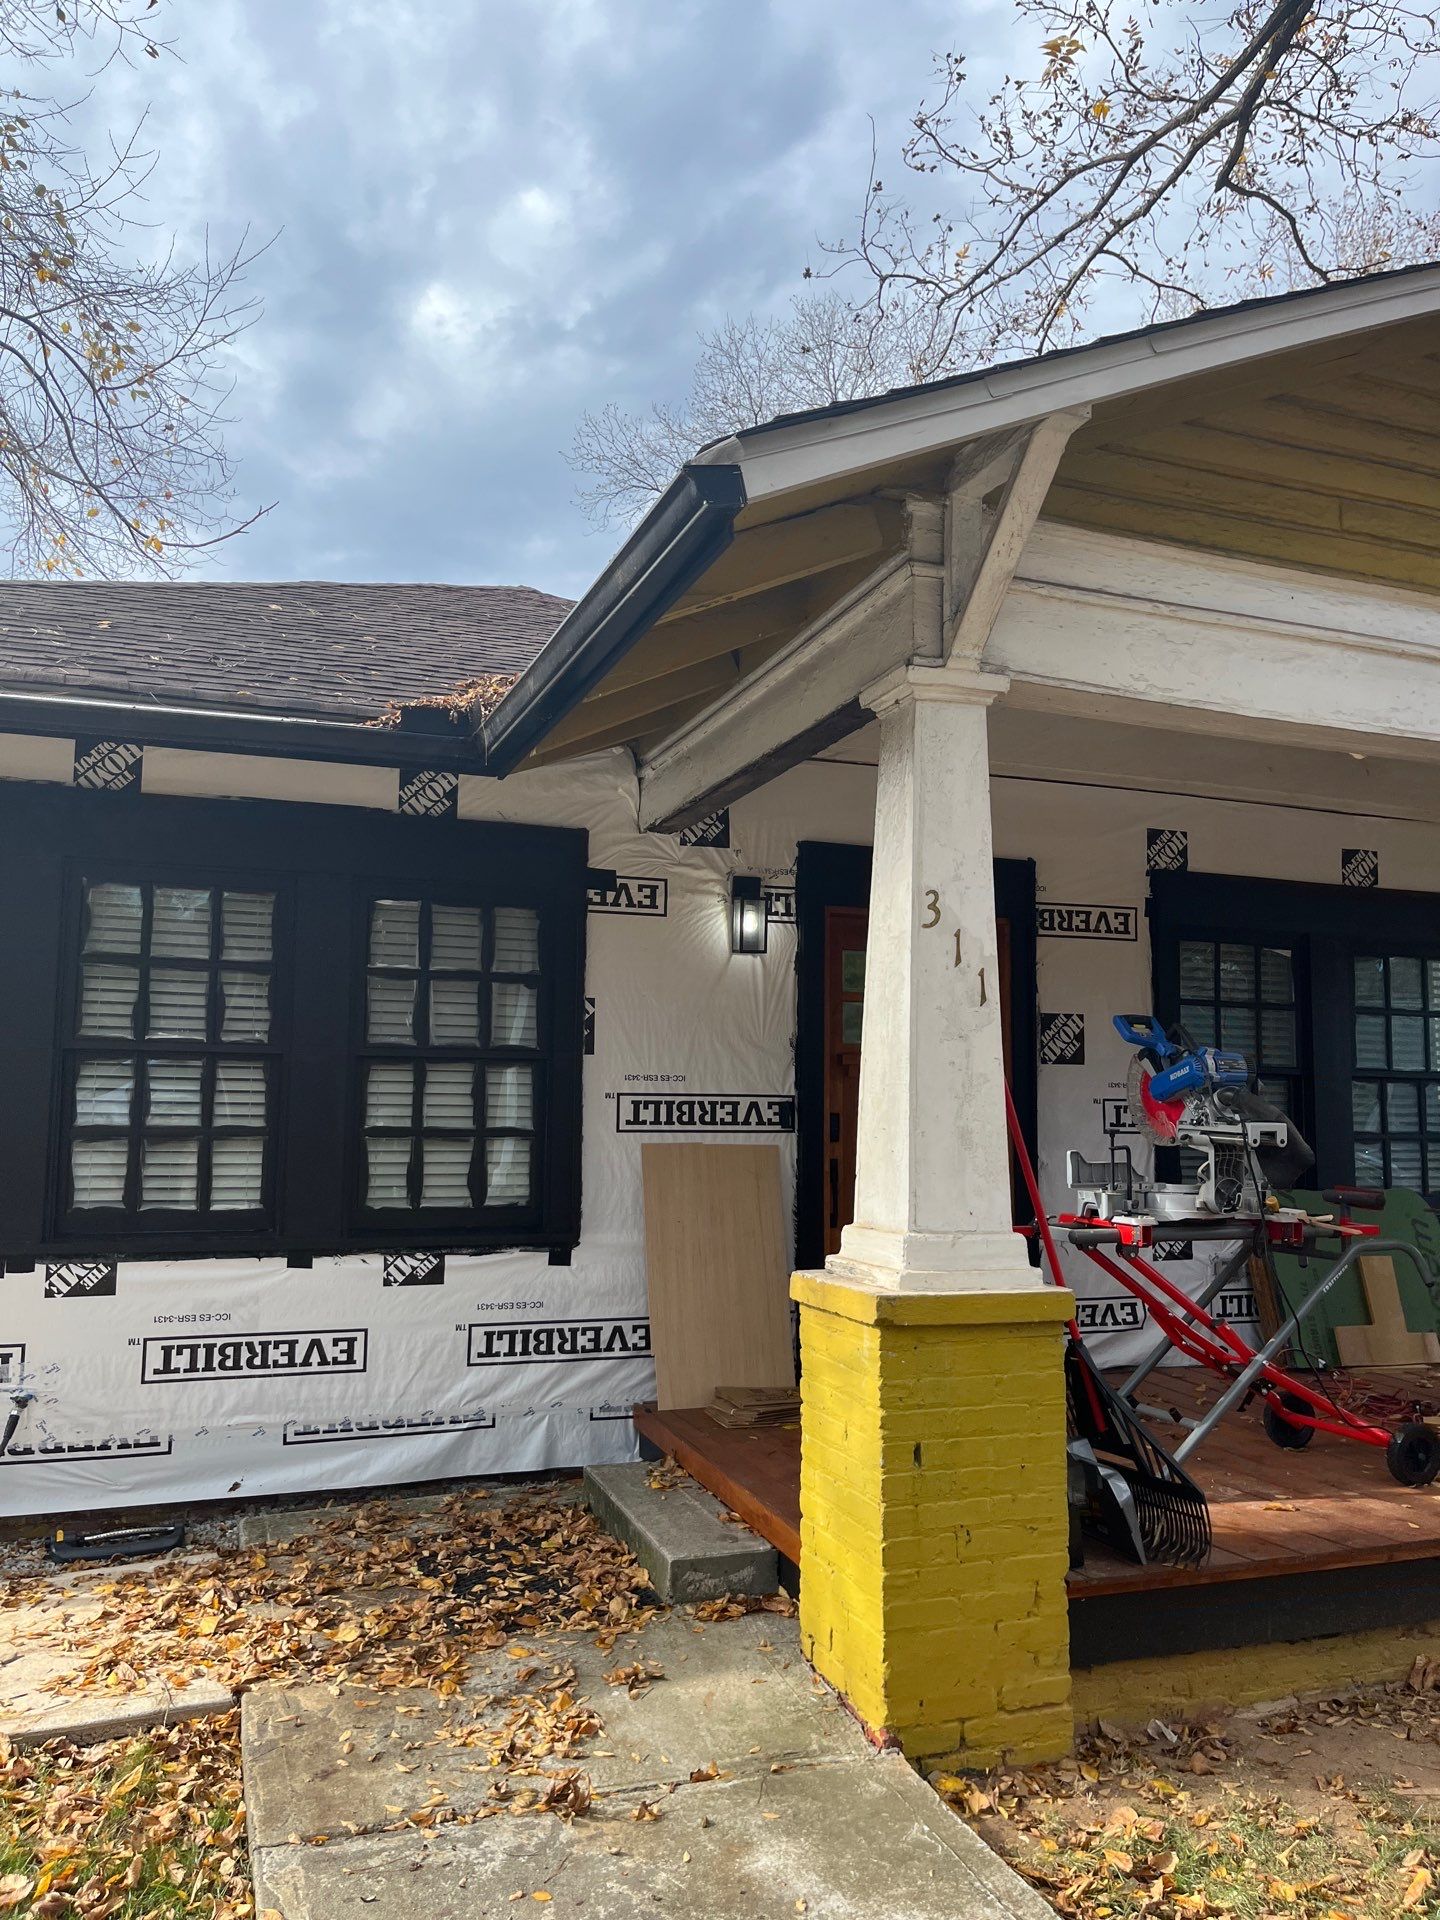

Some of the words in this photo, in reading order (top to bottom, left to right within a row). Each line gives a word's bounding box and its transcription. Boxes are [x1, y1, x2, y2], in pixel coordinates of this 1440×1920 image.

[74, 741, 118, 775] DEPOT
[107, 770, 136, 791] THE
[399, 770, 437, 802] DEPOT
[427, 797, 453, 818] THE
[703, 820, 725, 842] THE
[921, 889, 987, 1007] 311
[1040, 1013, 1068, 1046] DEPOT
[1040, 1013, 1085, 1064] HOME
[1061, 1039, 1081, 1060] THE
[624, 1074, 659, 1082] ESR-3431
[660, 1074, 686, 1082] ICC-ES
[625, 1099, 785, 1127] EVERBILT
[80, 1262, 111, 1291] THE
[413, 1254, 440, 1280] THE
[199, 1313, 231, 1322] ICC-ES
[477, 1302, 514, 1311] ESR-3431
[515, 1301, 544, 1310] ICC-ES
[153, 1315, 197, 1323] ESR-3431
[476, 1323, 651, 1359] EVERBILT
[152, 1336, 358, 1375] EVERBILT
